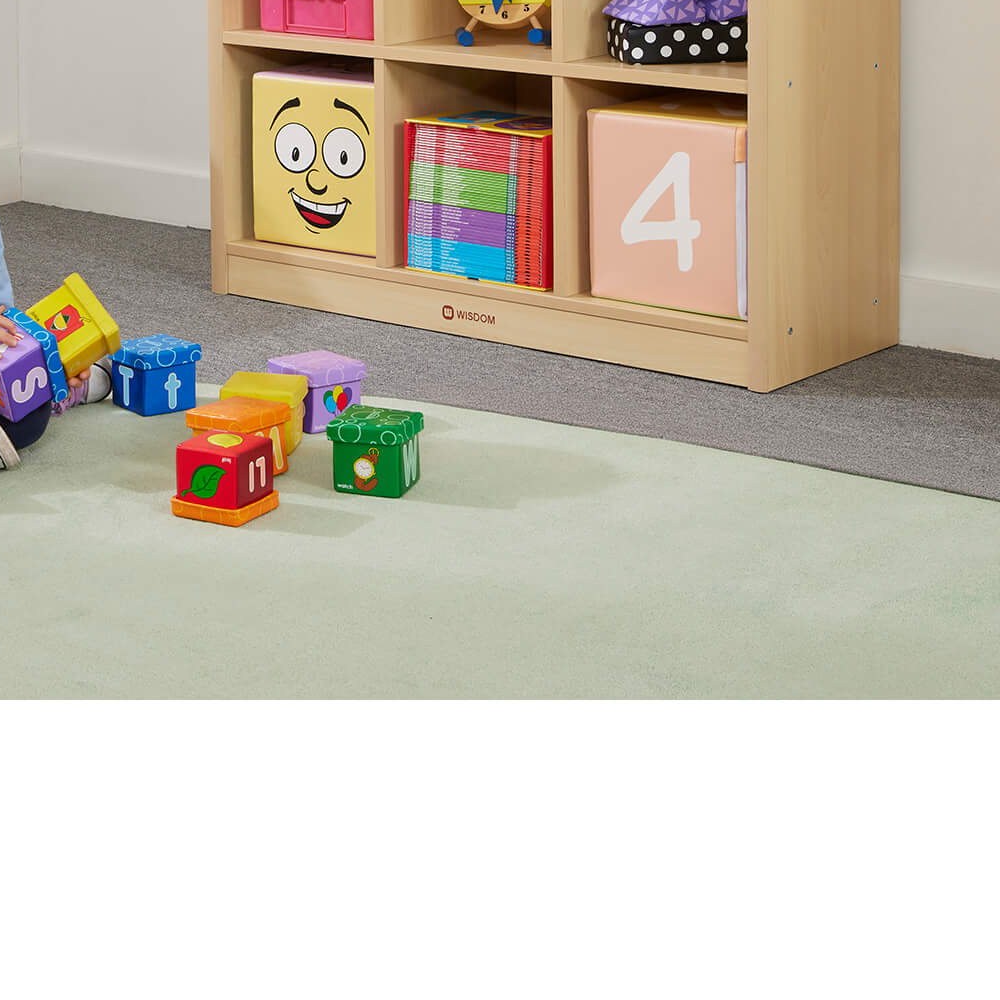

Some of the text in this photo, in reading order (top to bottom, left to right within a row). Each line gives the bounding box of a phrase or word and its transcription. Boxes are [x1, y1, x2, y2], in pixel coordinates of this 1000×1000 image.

[480, 4, 530, 14] 7 5
[501, 10, 508, 19] 6
[621, 151, 701, 272] 4
[456, 309, 496, 325] WISDOM
[117, 364, 134, 407] T
[164, 372, 181, 410] t
